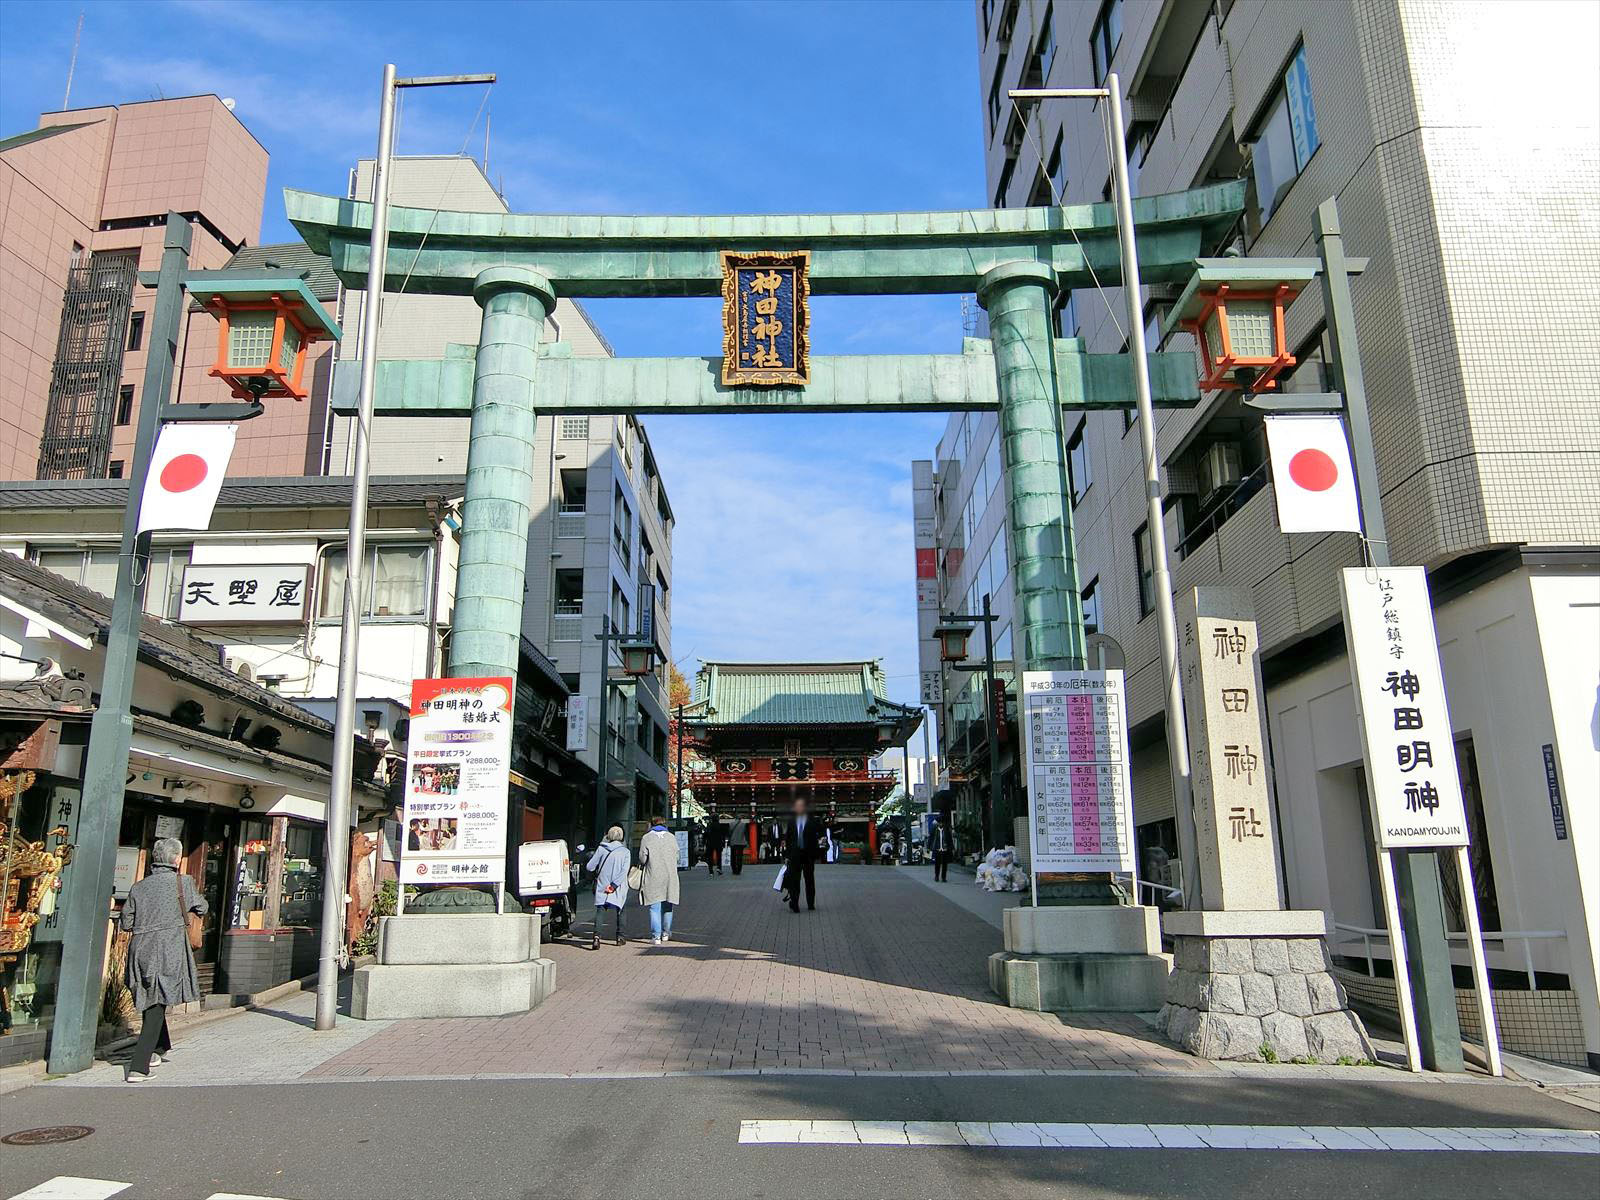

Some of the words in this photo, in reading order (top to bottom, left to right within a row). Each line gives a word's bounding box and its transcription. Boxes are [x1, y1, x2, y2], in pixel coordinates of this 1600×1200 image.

[750, 270, 783, 367] 神田神社
[1379, 577, 1404, 659] 江戸総鎮守
[421, 699, 483, 710] 神田明神の
[463, 711, 500, 723] 結婚式
[1033, 713, 1042, 755] 男の厄年
[1213, 627, 1264, 842] 神田神社
[1381, 669, 1439, 816] 神田明神
[410, 803, 456, 811] 特別挙式プラン
[1037, 792, 1046, 836] 女の厄年
[1387, 826, 1460, 836] KANDAMYOUJIN
[451, 863, 488, 874] 明神会館
